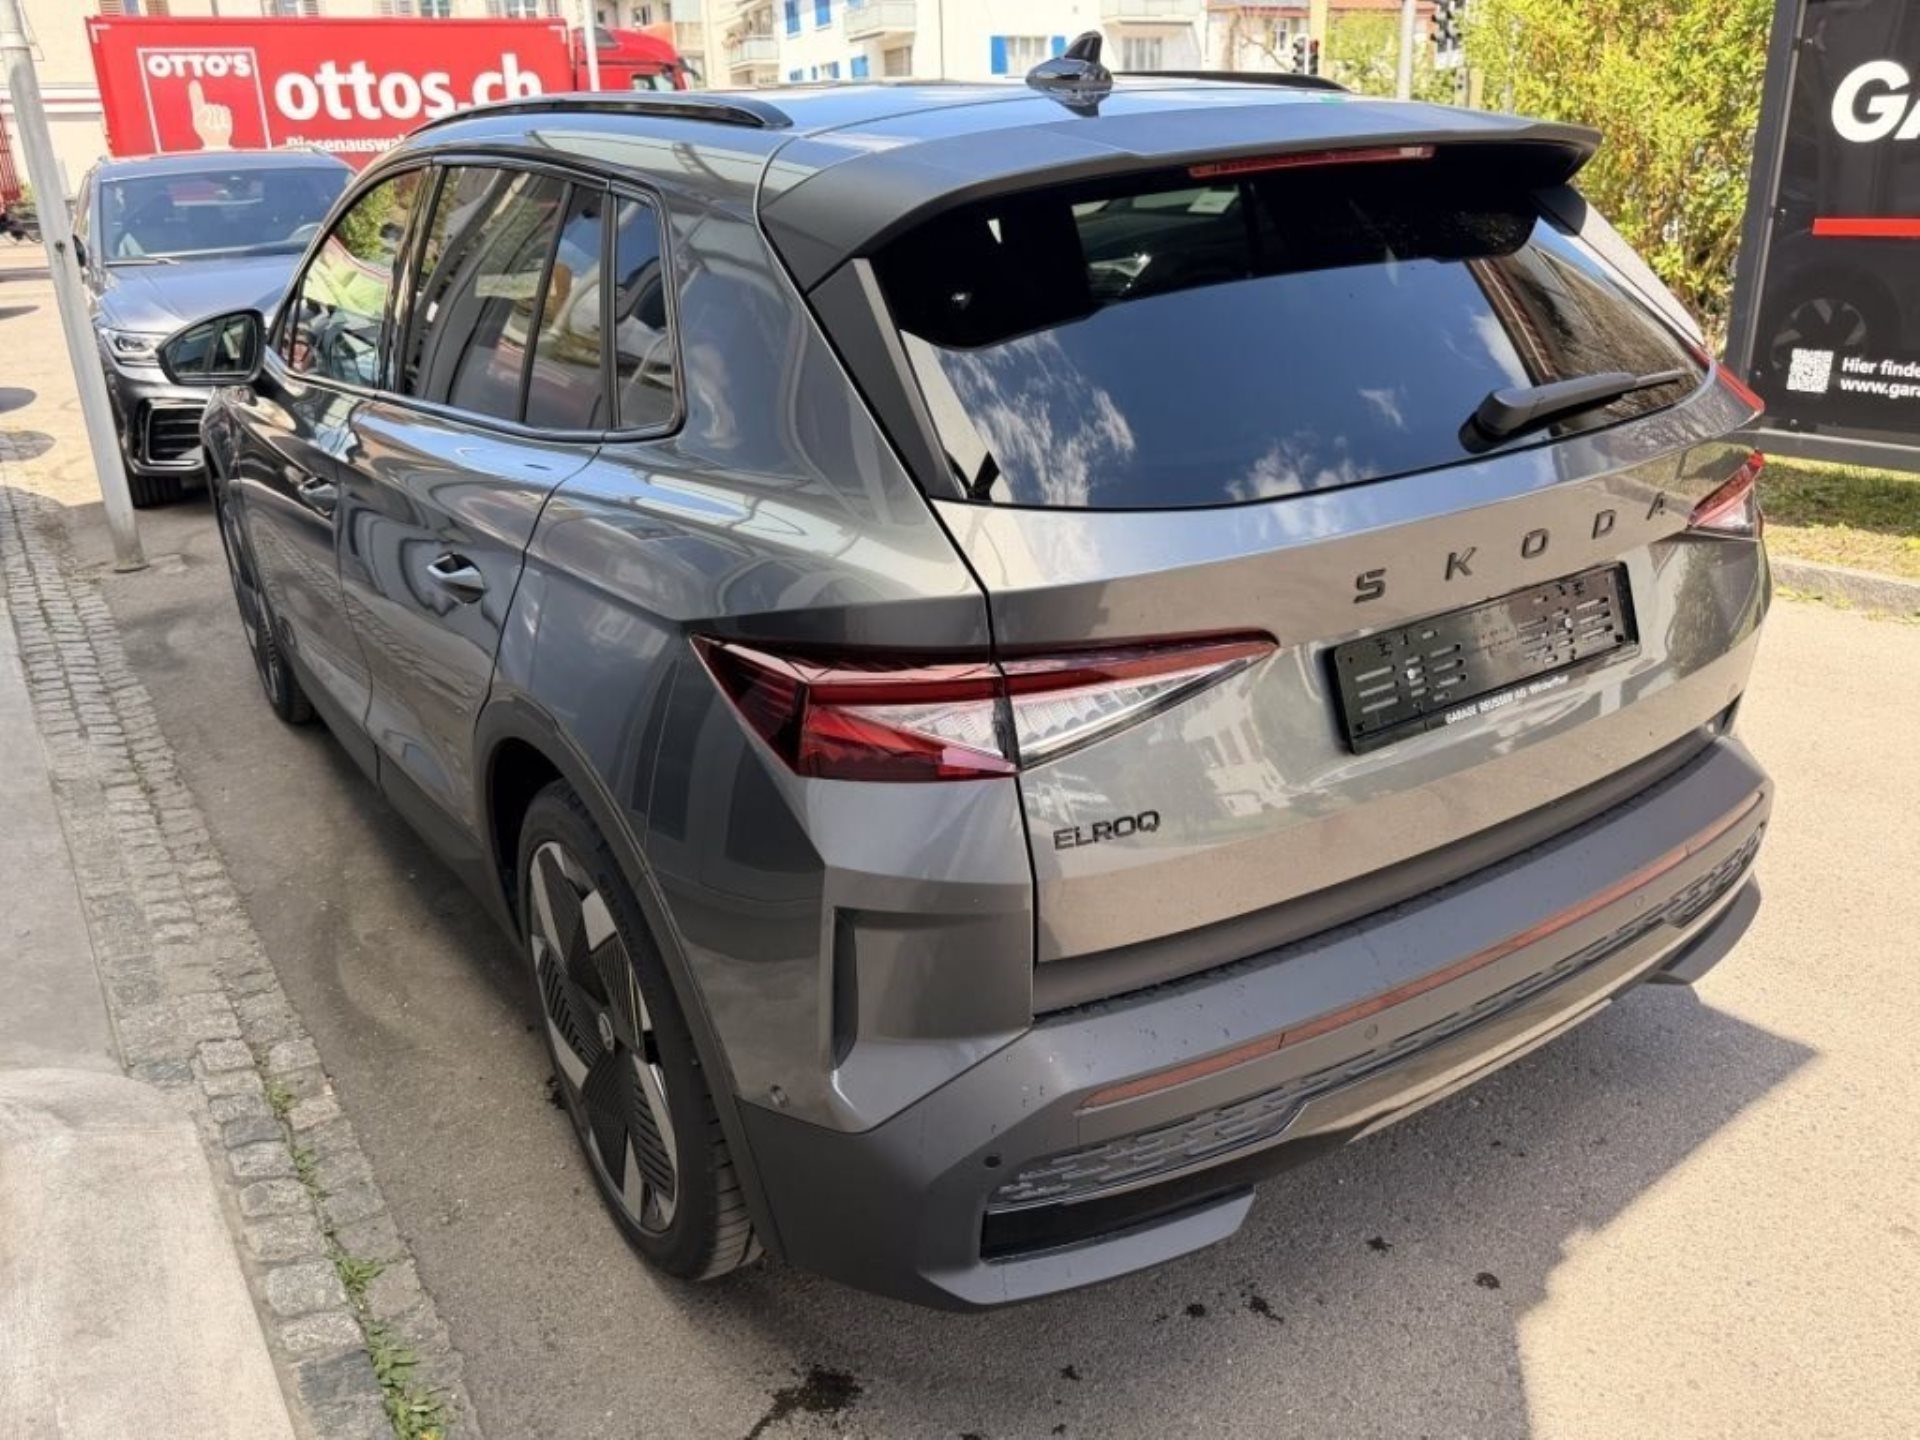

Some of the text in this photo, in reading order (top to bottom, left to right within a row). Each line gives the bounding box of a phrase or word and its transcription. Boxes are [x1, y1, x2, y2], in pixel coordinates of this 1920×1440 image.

[147, 54, 251, 78] OTTO'S
[274, 52, 543, 121] ottos.ch
[1842, 356, 1877, 374] Hier
[1353, 491, 1665, 603] SKODA
[1053, 810, 1160, 851] ELROQ
